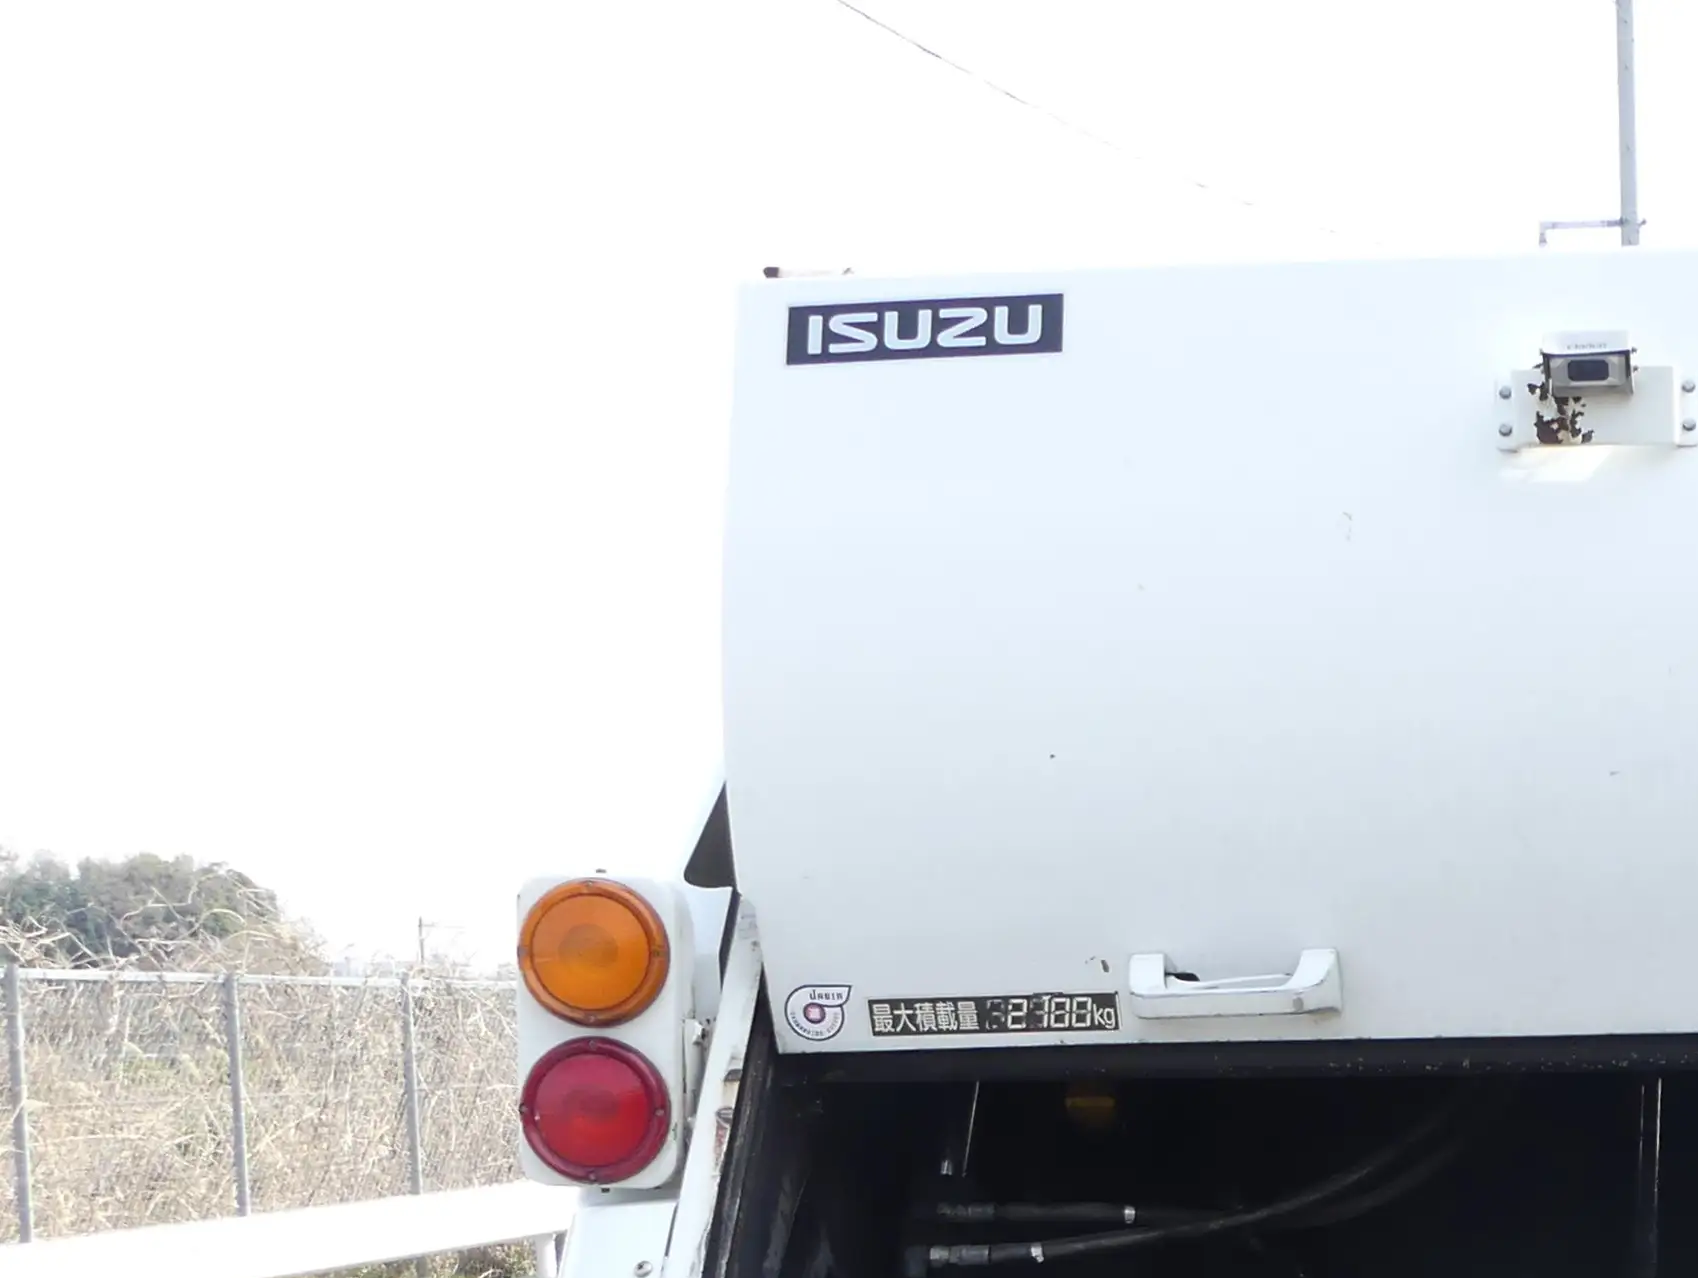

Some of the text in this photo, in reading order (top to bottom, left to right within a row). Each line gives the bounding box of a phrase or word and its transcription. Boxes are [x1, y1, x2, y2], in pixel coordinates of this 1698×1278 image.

[807, 304, 1043, 355] ISUZU
[872, 1001, 979, 1034] 最大積載量
